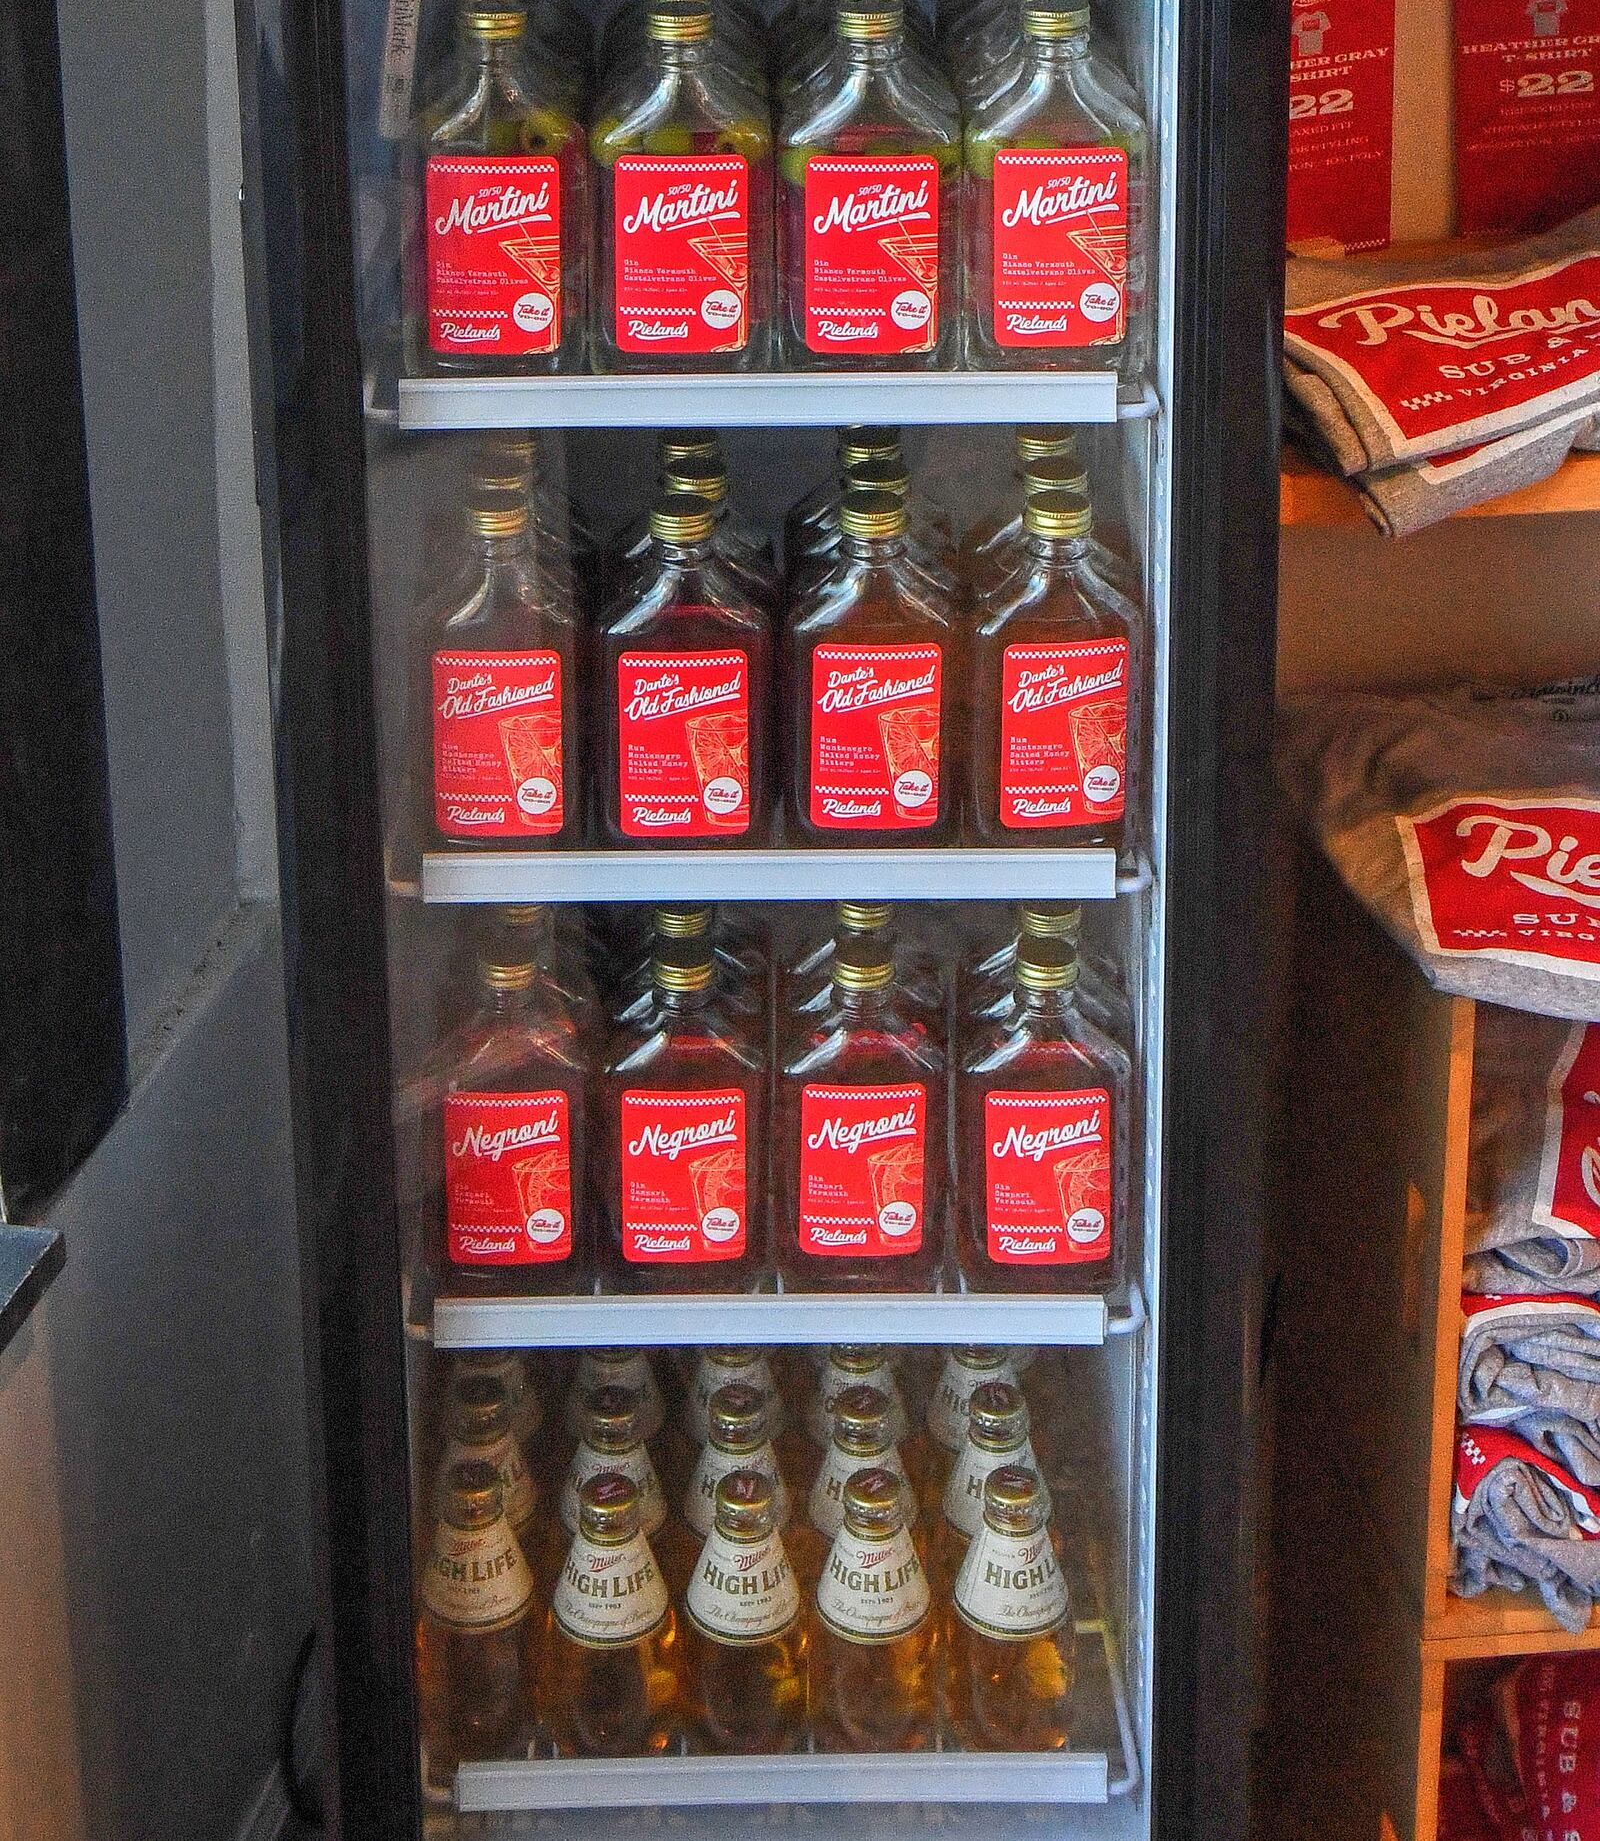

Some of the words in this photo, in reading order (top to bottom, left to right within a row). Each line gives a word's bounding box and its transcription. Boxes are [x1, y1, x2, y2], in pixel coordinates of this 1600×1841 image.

[1573, 35, 1600, 45] GR
[1290, 56, 1331, 70] HER
[1334, 47, 1389, 63] GRAY
[1290, 65, 1353, 82] SHIRT
[1500, 70, 1594, 97] $22
[1290, 88, 1354, 119] 22
[477, 185, 502, 199] 50/50
[667, 184, 692, 197] 50/50
[857, 184, 882, 197] 50/50
[1046, 176, 1071, 189] 50/50
[435, 181, 552, 236] Martini
[623, 179, 741, 234] Martini
[813, 180, 931, 234] Martini
[1002, 171, 1120, 227] Martini
[706, 301, 728, 313] Take
[896, 301, 918, 314] Take
[1085, 293, 1106, 306] Take
[440, 322, 500, 343] Pielands
[627, 319, 688, 341] Pielands
[817, 320, 878, 341] Pielands
[1006, 314, 1068, 335] Pielands
[1318, 294, 1600, 349] Pielan
[1438, 353, 1532, 379] SUB
[1547, 336, 1574, 348] &
[1458, 347, 1589, 397] VIRGINIA
[447, 672, 493, 694] Dante's
[634, 674, 680, 695] Dante's
[827, 665, 875, 688] Dante's
[1007, 687, 1044, 713] Old
[1044, 659, 1124, 705] Fashioned
[1018, 663, 1066, 688] Dante's
[437, 695, 473, 720] Old
[474, 672, 554, 712] Fashioned
[624, 694, 660, 721] Old
[660, 671, 741, 713] Fashioned
[817, 688, 854, 713] Old
[854, 664, 936, 706] Fashioned
[447, 805, 505, 825] Pielands
[632, 806, 691, 827] Pielands
[822, 798, 881, 819] Pielands
[1012, 797, 1071, 818] Pielands
[1456, 815, 1600, 899] Pie
[1518, 929, 1597, 941] VIRG
[452, 1110, 561, 1161] Negroni
[628, 1110, 738, 1160] Negroni
[808, 1103, 917, 1154] Negroni
[992, 1110, 1102, 1162] Negroni
[460, 1236, 516, 1255] Pielands
[634, 1234, 691, 1253] Pielands
[810, 1227, 867, 1246] Pielands
[998, 1236, 1056, 1255] Pielands
[471, 1546, 518, 1582] LIFE
[587, 1553, 627, 1573] Miller
[733, 1545, 770, 1572] Miller
[856, 1547, 895, 1569] Miller
[565, 1557, 608, 1599] HIGH
[613, 1561, 655, 1597] LIFE
[703, 1558, 759, 1596] HIGH
[762, 1562, 789, 1592] LIF
[830, 1552, 880, 1593] HIGH
[984, 1561, 1045, 1590] HIGH
